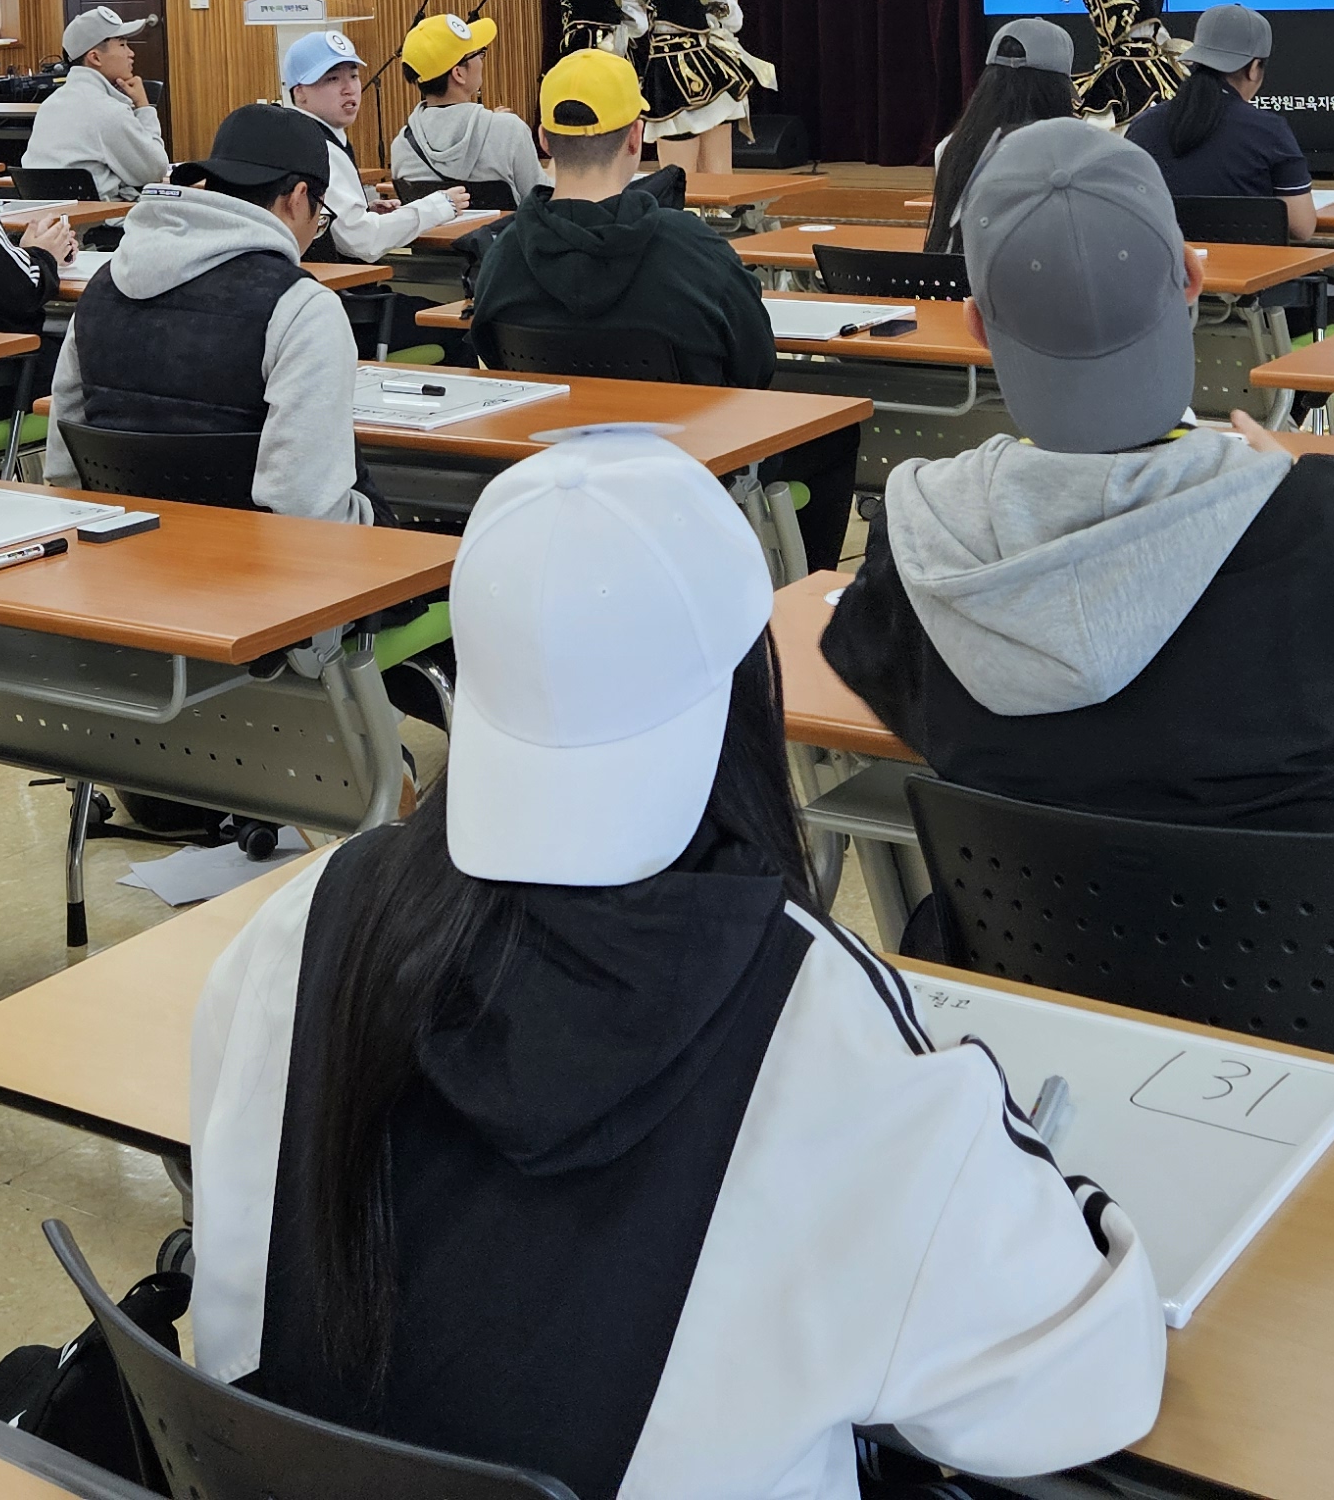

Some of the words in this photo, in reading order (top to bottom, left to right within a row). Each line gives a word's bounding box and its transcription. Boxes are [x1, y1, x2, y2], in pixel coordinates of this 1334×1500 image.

[451, 21, 465, 33] 3
[332, 35, 346, 51] 9
[1202, 1059, 1291, 1118] 31
